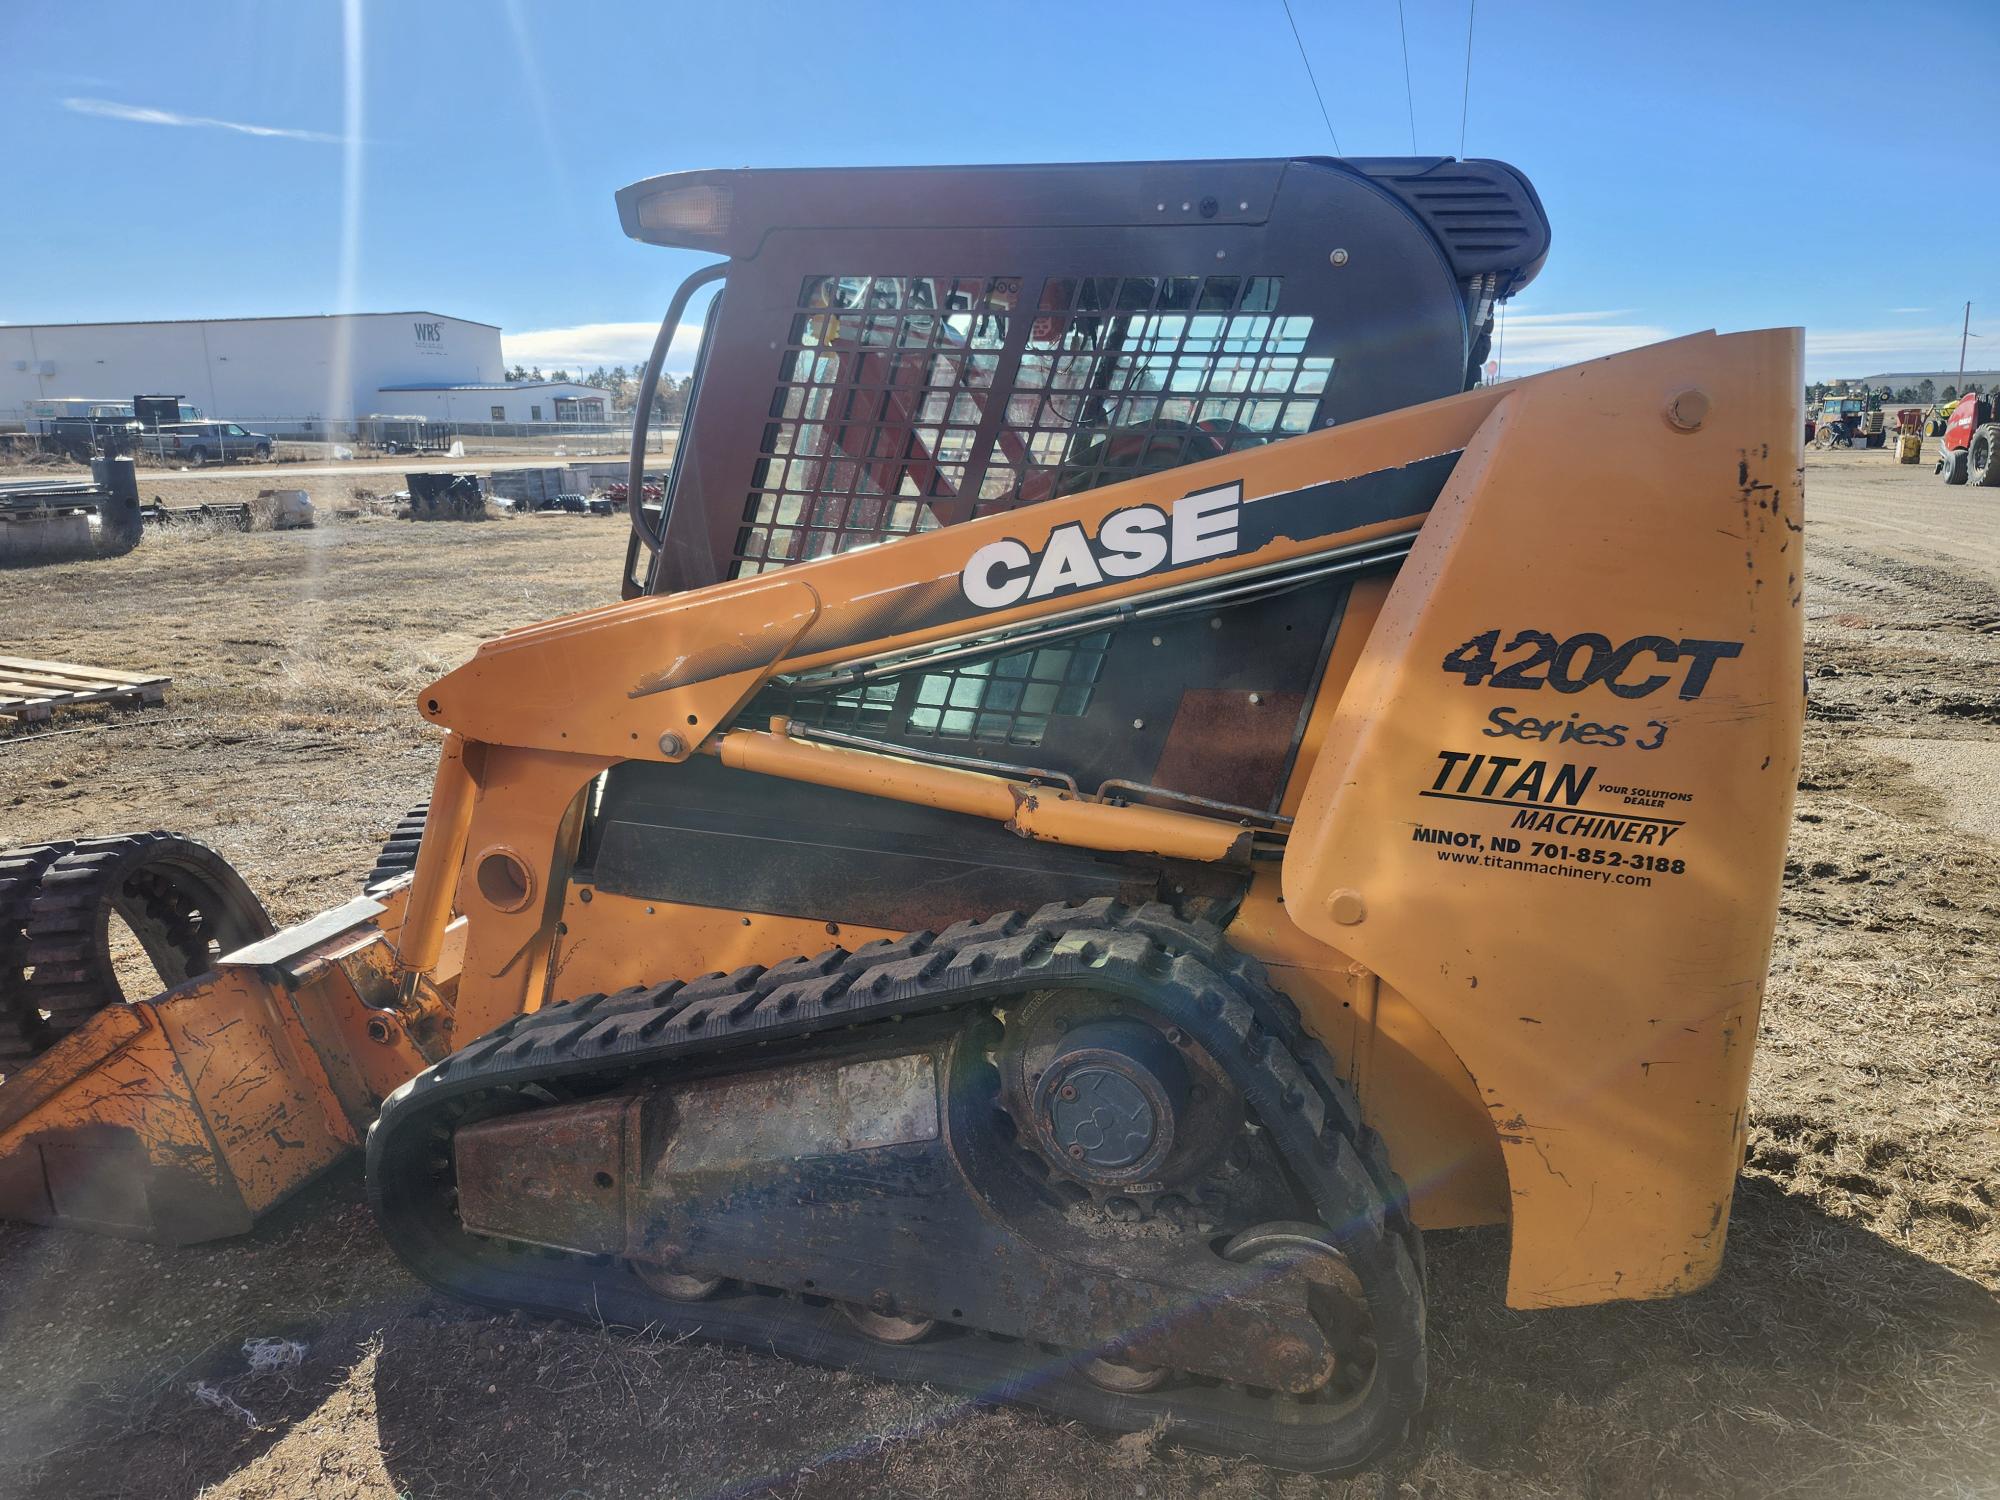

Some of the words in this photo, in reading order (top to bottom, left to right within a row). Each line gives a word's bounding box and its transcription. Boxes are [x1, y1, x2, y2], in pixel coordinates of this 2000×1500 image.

[414, 322, 440, 341] WRS
[962, 484, 1240, 609] CASE
[1442, 629, 1744, 701] 420CT
[1482, 706, 1629, 747] Series
[1636, 720, 1669, 750] 3
[1431, 750, 1598, 806] TITAN
[1598, 784, 1629, 796] YOUR
[1631, 787, 1693, 802] SOLUTIONS
[1623, 796, 1665, 808] DEALER
[1511, 809, 1679, 847] MACHINERY
[1412, 827, 1485, 853] MINOT,
[1490, 836, 1521, 854] ND
[1530, 841, 1686, 875] 701-852-3188
[1437, 850, 1652, 888] www.titanmachinery.com
